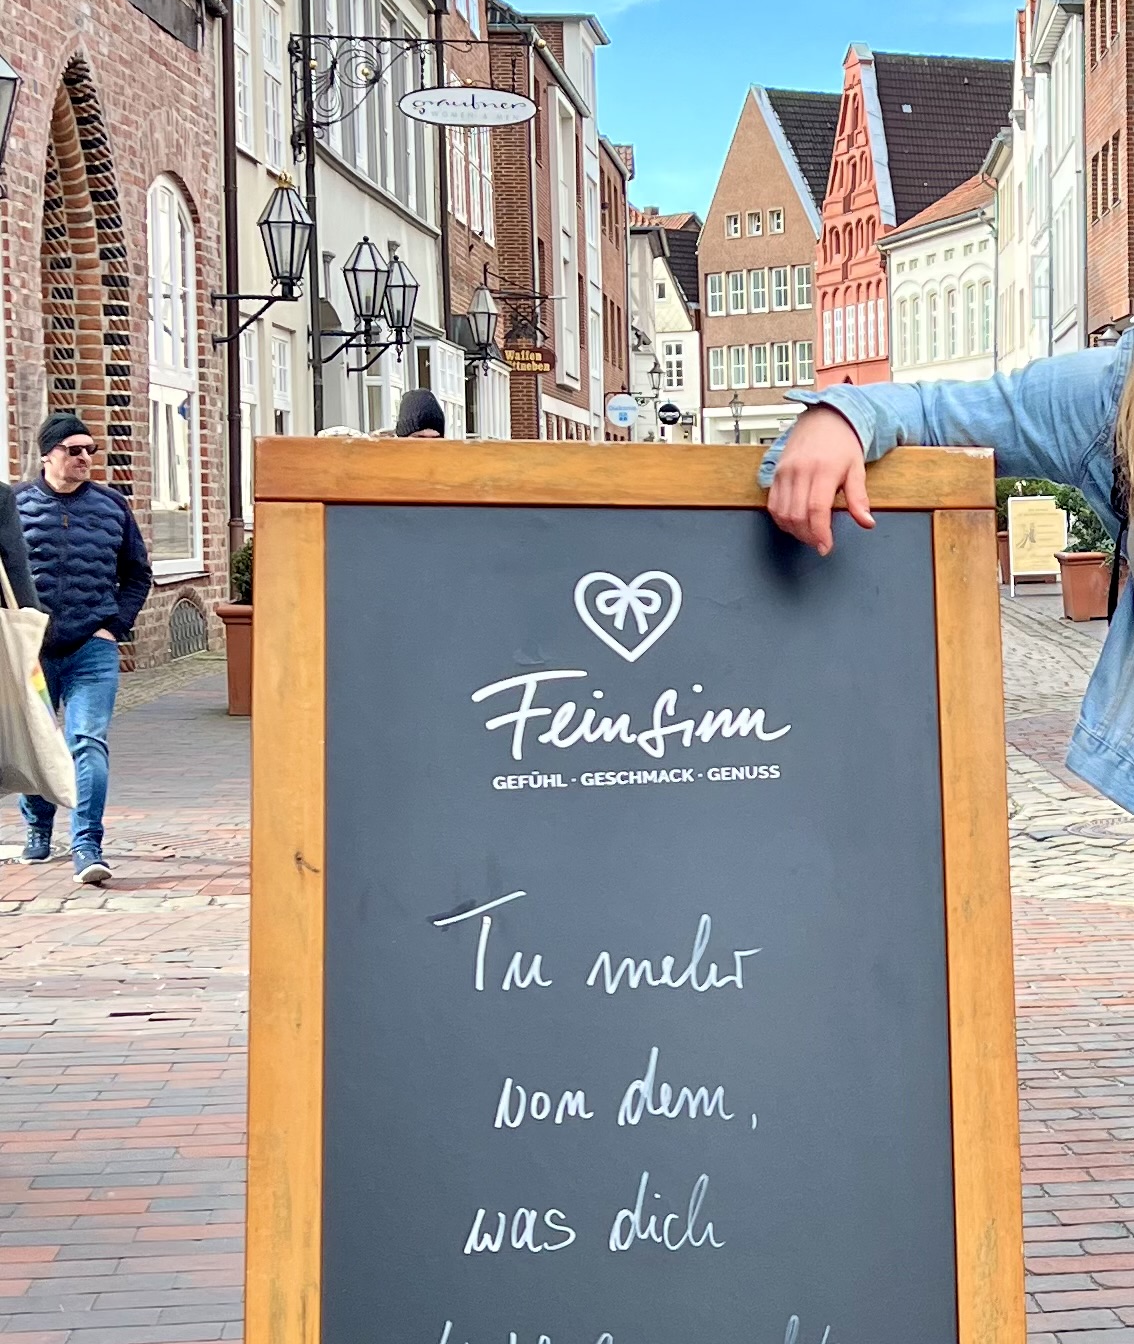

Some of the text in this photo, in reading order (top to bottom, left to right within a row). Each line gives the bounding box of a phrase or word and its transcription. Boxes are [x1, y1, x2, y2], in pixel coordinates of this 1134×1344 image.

[504, 349, 542, 361] Waffen
[492, 771, 568, 789] GEFÜHL
[581, 768, 694, 786] GESCHMACK
[707, 765, 781, 781] GENUSS
[434, 891, 762, 994] Tu mehr
[495, 1078, 594, 1128] von
[464, 1171, 725, 1254] was dich
